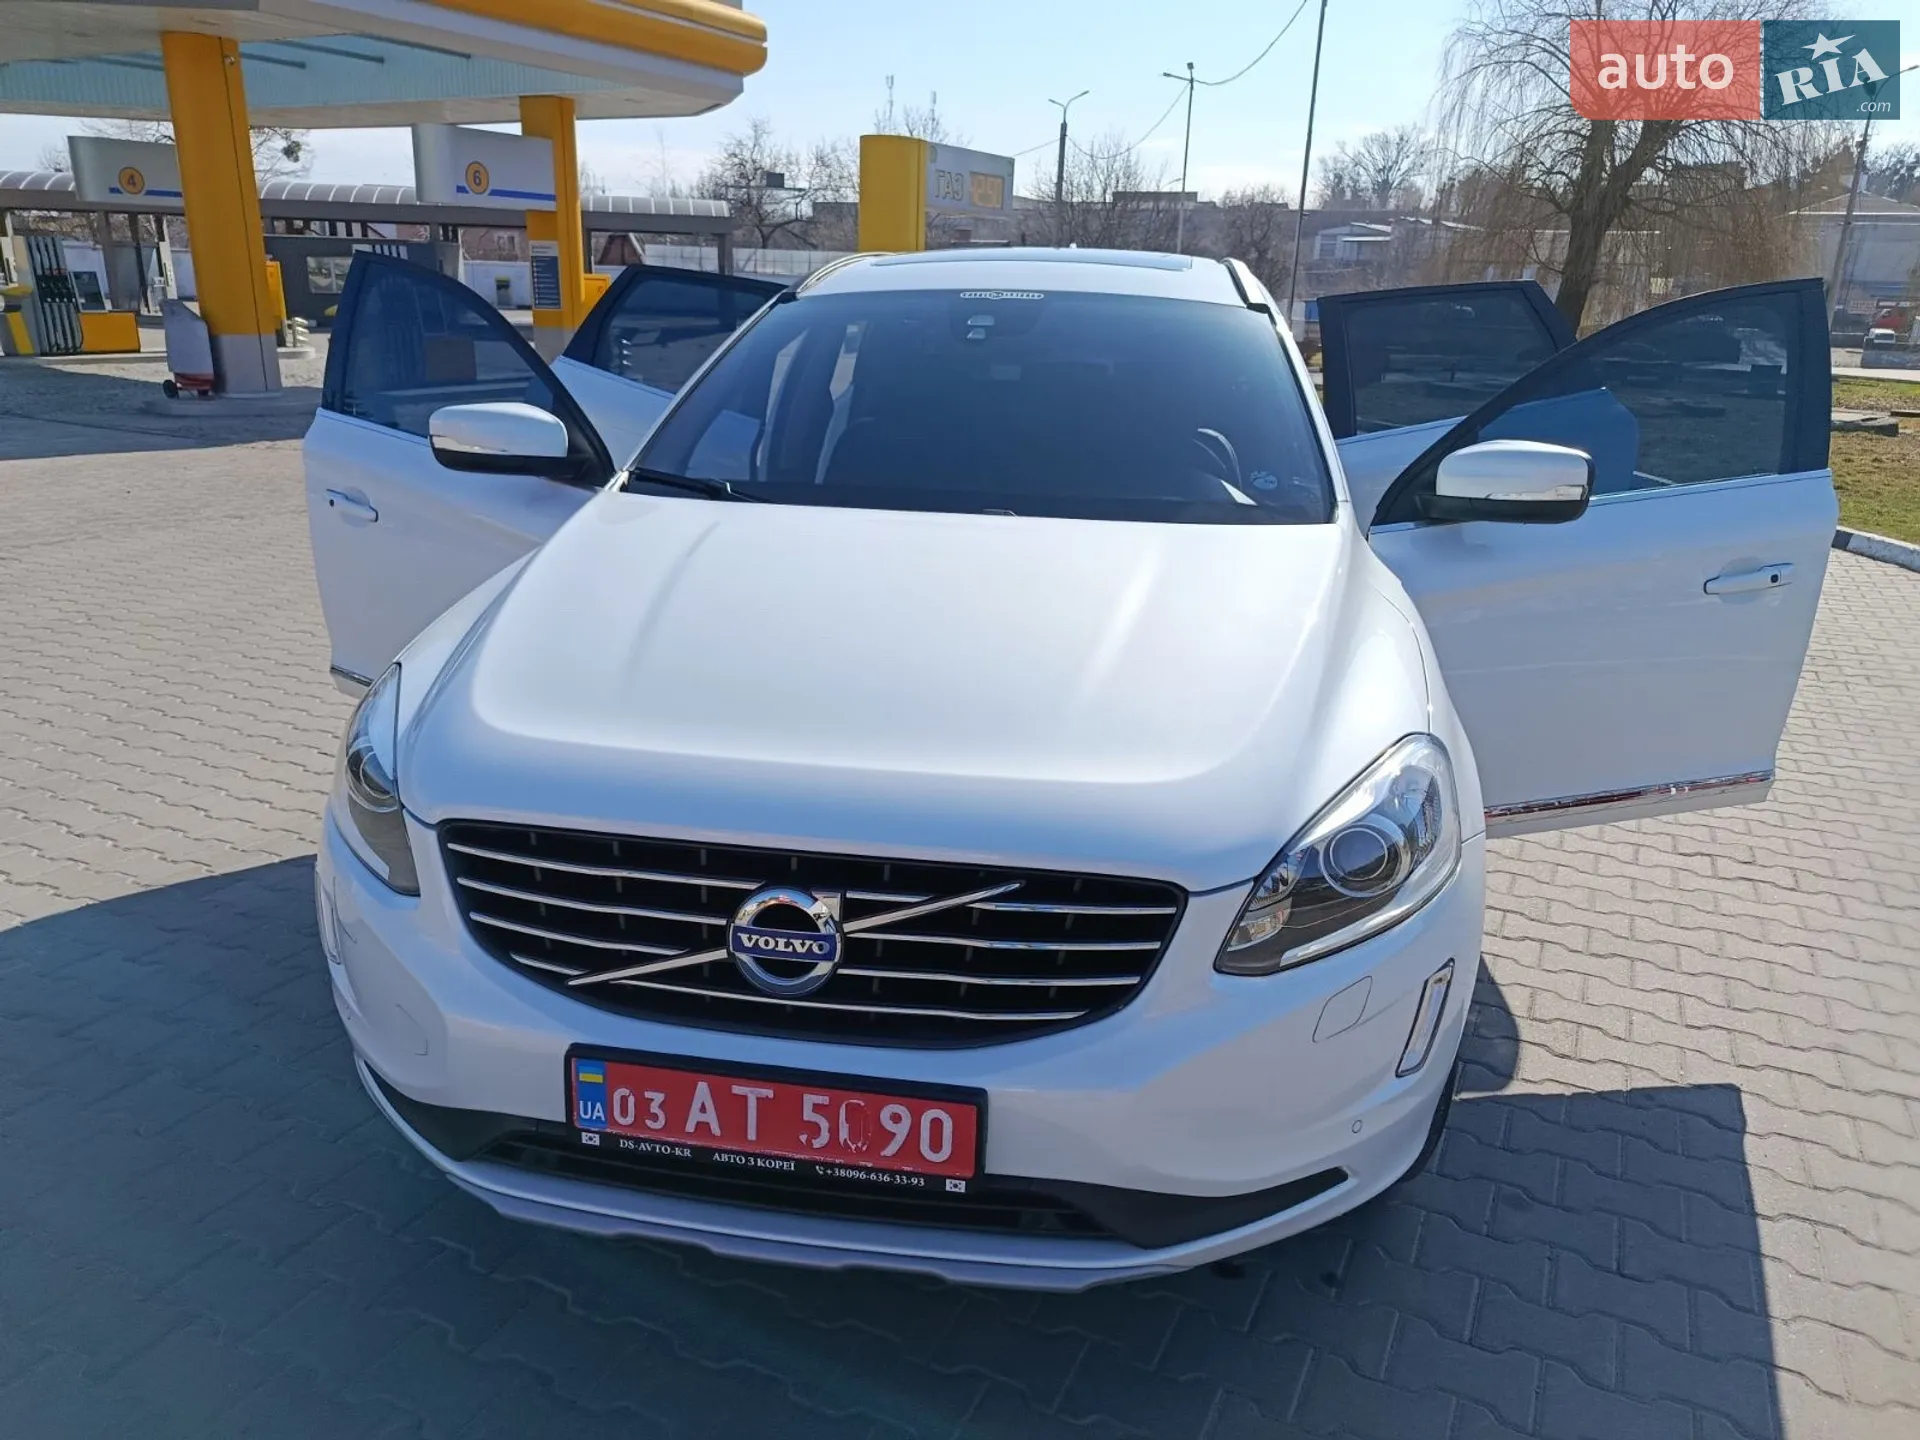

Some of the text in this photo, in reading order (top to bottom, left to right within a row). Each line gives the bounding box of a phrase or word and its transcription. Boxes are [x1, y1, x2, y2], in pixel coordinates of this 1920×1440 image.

[127, 173, 137, 188] 4
[473, 170, 482, 187] 6
[935, 168, 964, 201] ГАЗ
[737, 932, 831, 954] VOLVO
[579, 1100, 605, 1122] UA
[613, 1087, 666, 1130] 03
[684, 1081, 774, 1141] AT
[619, 1138, 692, 1157] DS-AVTO-KR
